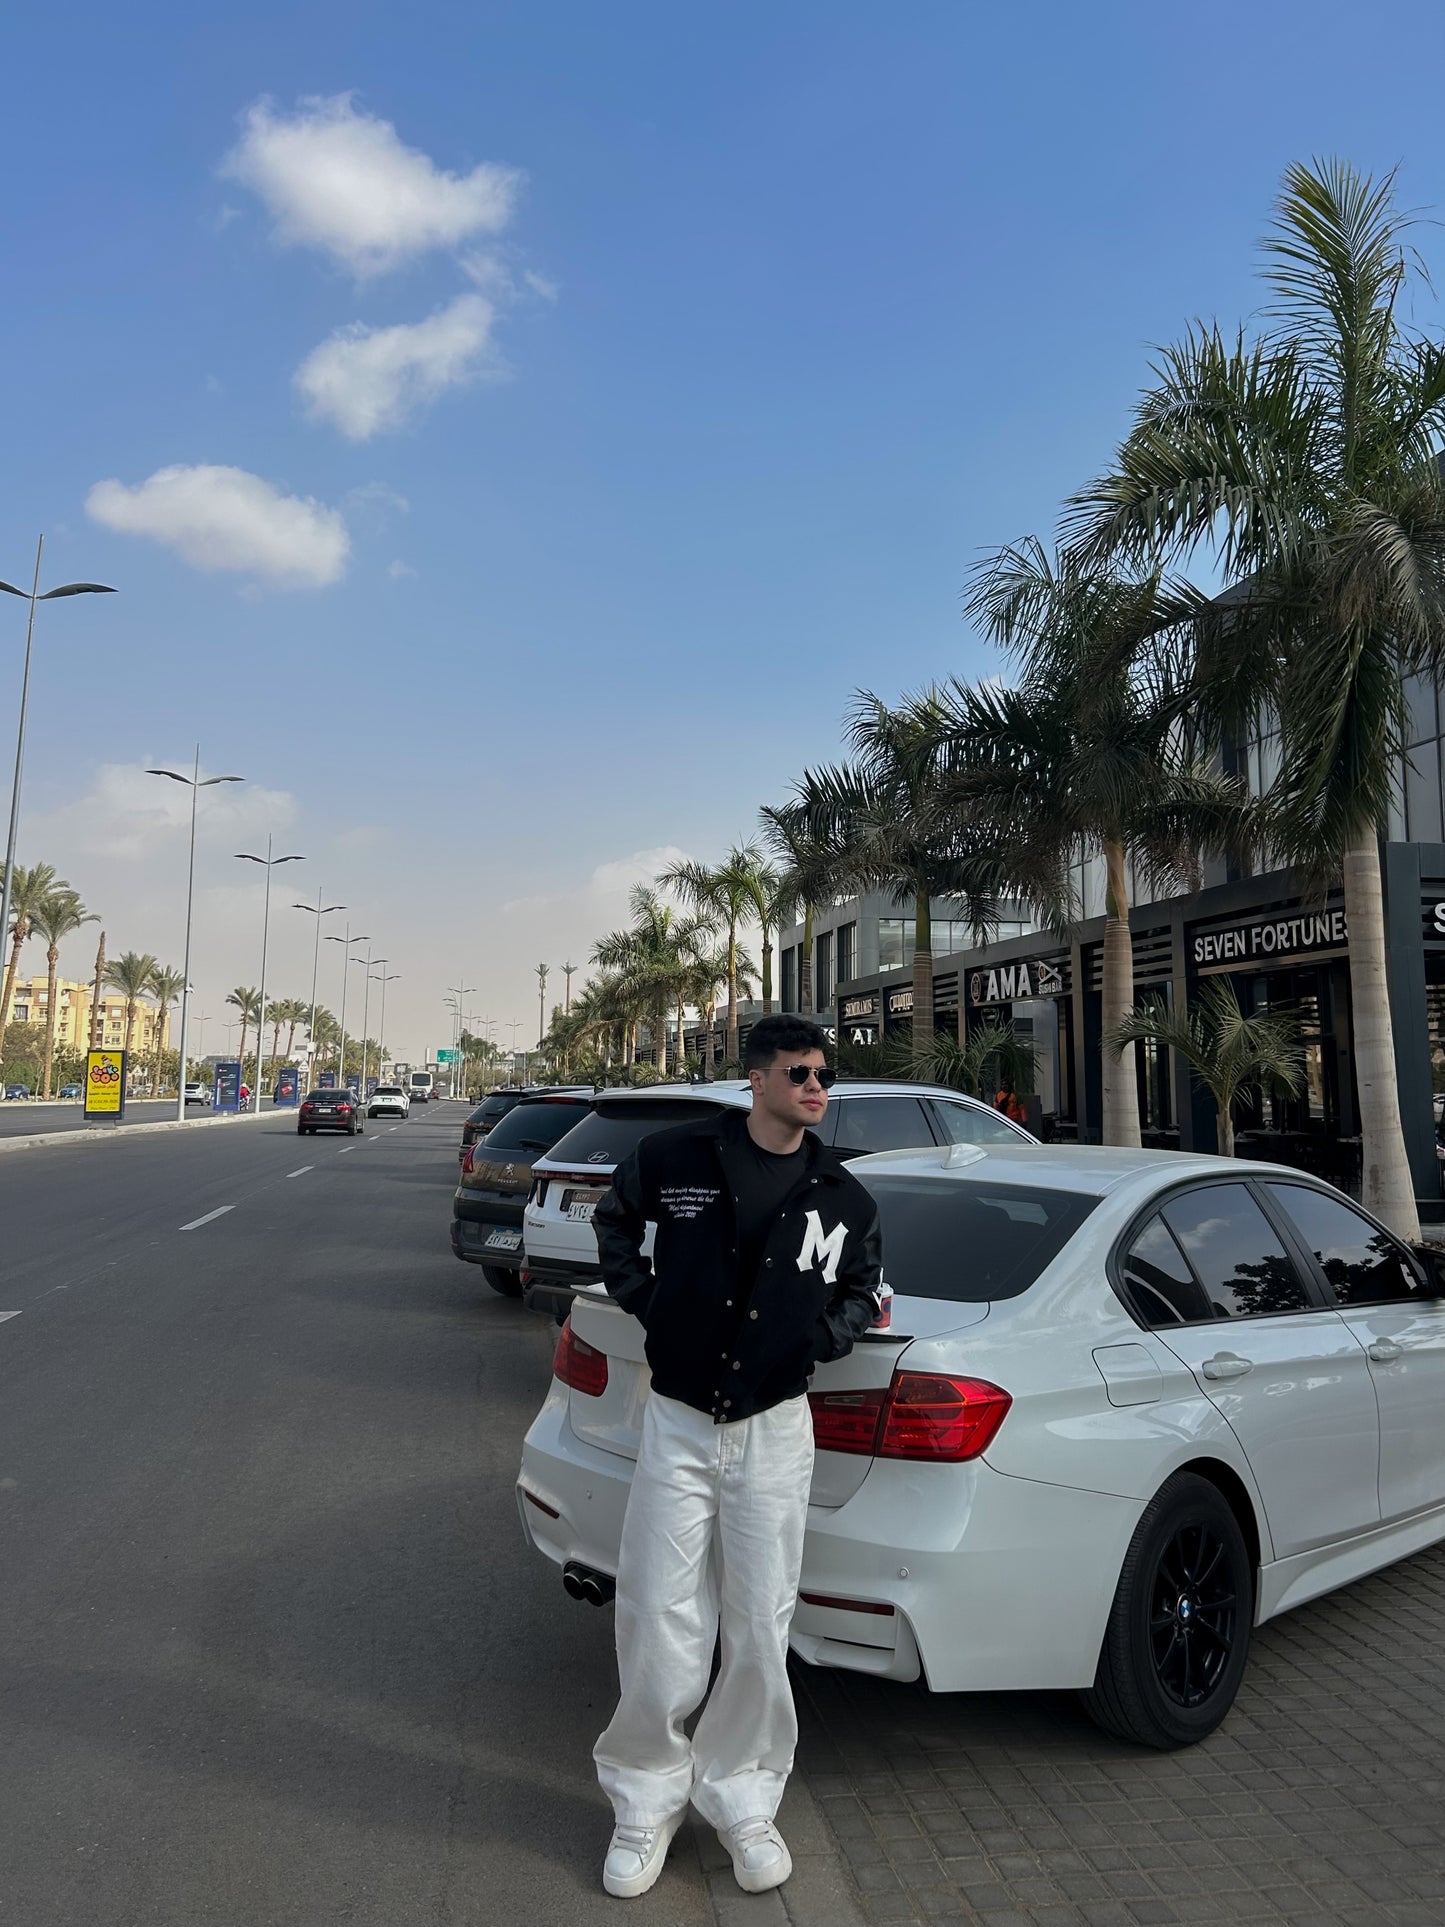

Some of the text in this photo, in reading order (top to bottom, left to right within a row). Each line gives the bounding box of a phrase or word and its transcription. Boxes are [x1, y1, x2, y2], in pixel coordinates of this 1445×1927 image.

[1194, 930, 1246, 963] SEVEN
[986, 963, 1033, 1001] AMA
[796, 1210, 849, 1284] M
